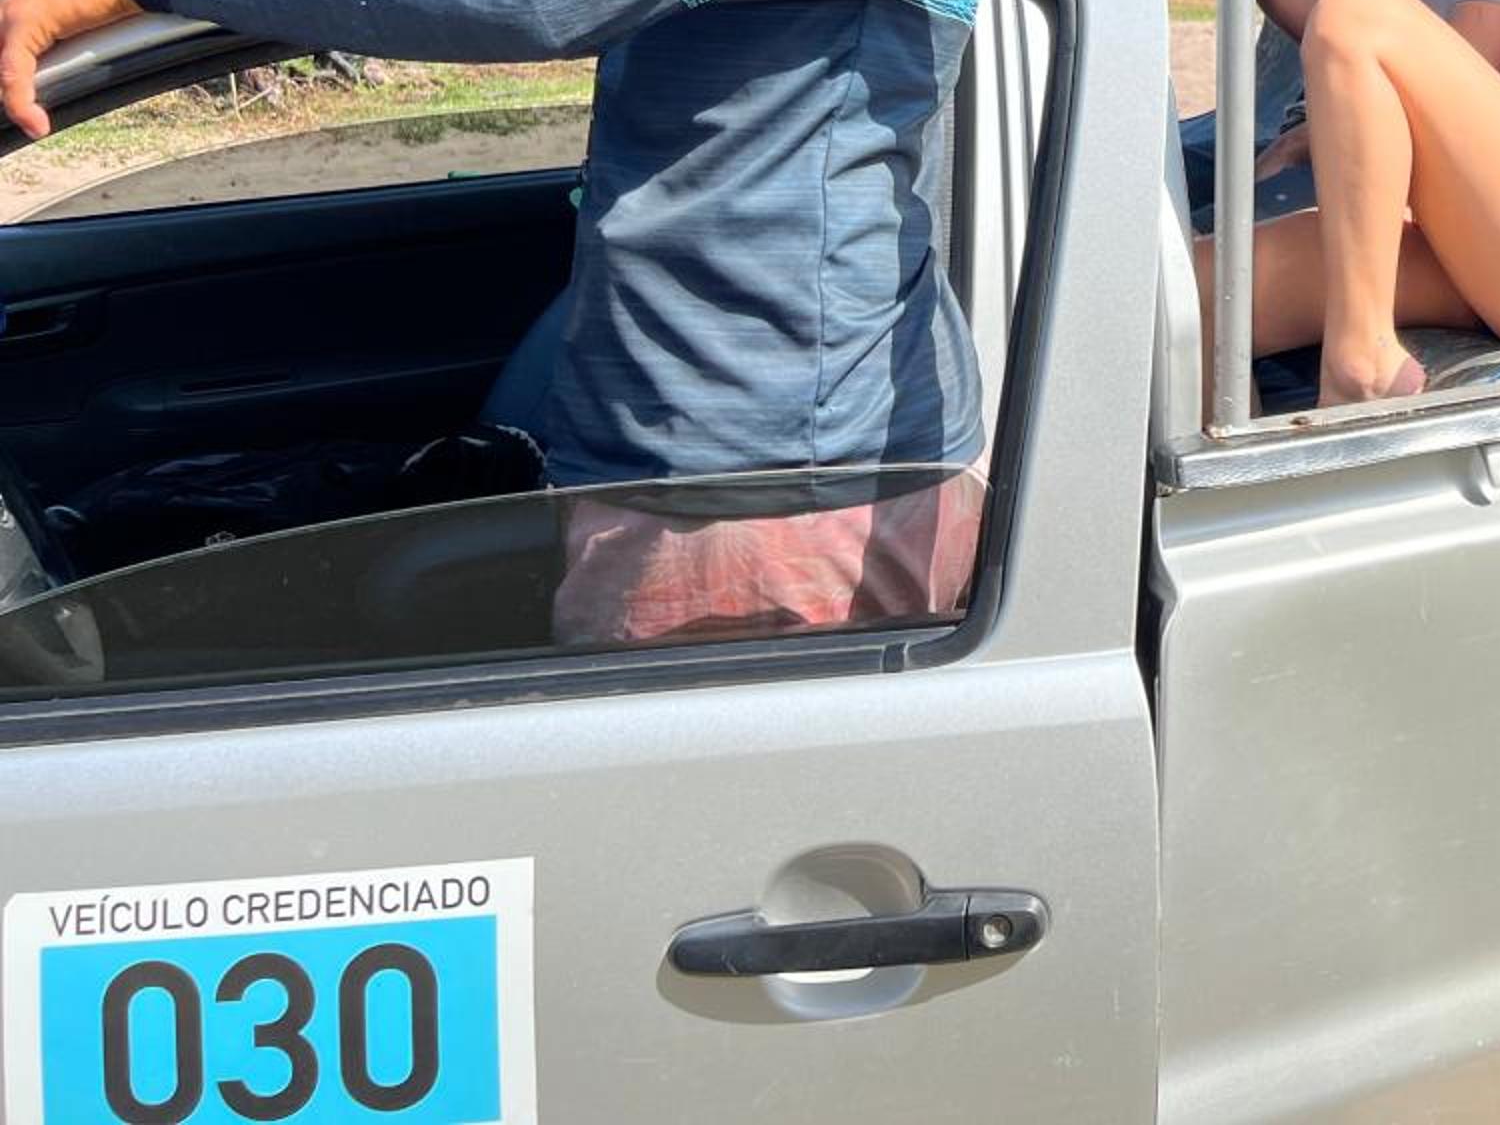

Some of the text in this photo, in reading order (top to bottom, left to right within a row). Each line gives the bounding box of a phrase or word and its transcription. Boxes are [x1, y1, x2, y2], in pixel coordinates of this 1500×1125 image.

[49, 875, 491, 937] VEÍCULO CREDENCIADO
[102, 943, 439, 1125] 030
